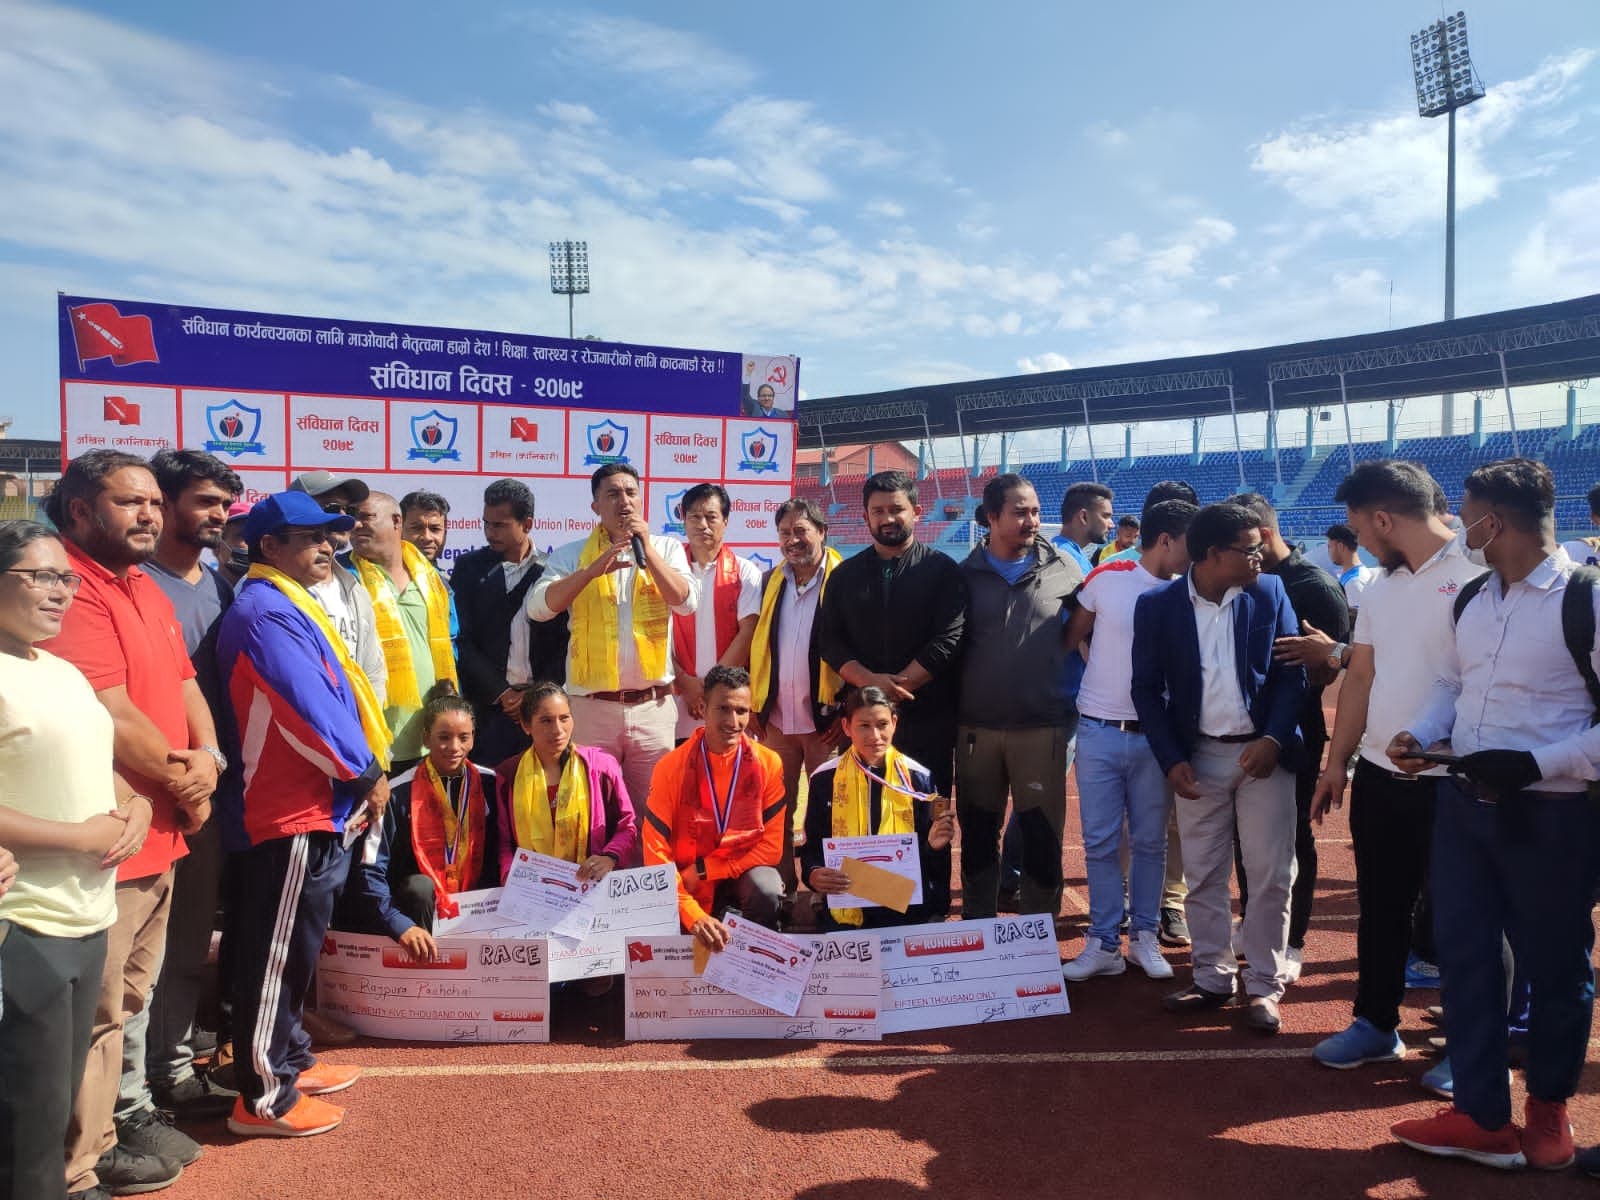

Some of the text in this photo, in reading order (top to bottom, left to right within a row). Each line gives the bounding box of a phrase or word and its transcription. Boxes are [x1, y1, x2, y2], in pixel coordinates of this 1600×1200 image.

[182, 315, 230, 337] संविधान
[316, 327, 344, 345] लागि
[348, 330, 398, 350] माओवादी
[474, 338, 491, 357] देश
[634, 352, 657, 369] लागि
[369, 361, 453, 392] संविधान
[459, 365, 513, 396] दिवस
[533, 377, 584, 399] २०७९
[296, 414, 380, 433] संविधान दिवस
[654, 431, 718, 448] संविधान दिवस
[444, 518, 481, 529] endent
[534, 519, 561, 530] Union
[609, 870, 669, 898] RACE
[995, 919, 1048, 944] RACE
[481, 945, 541, 966] RACE
